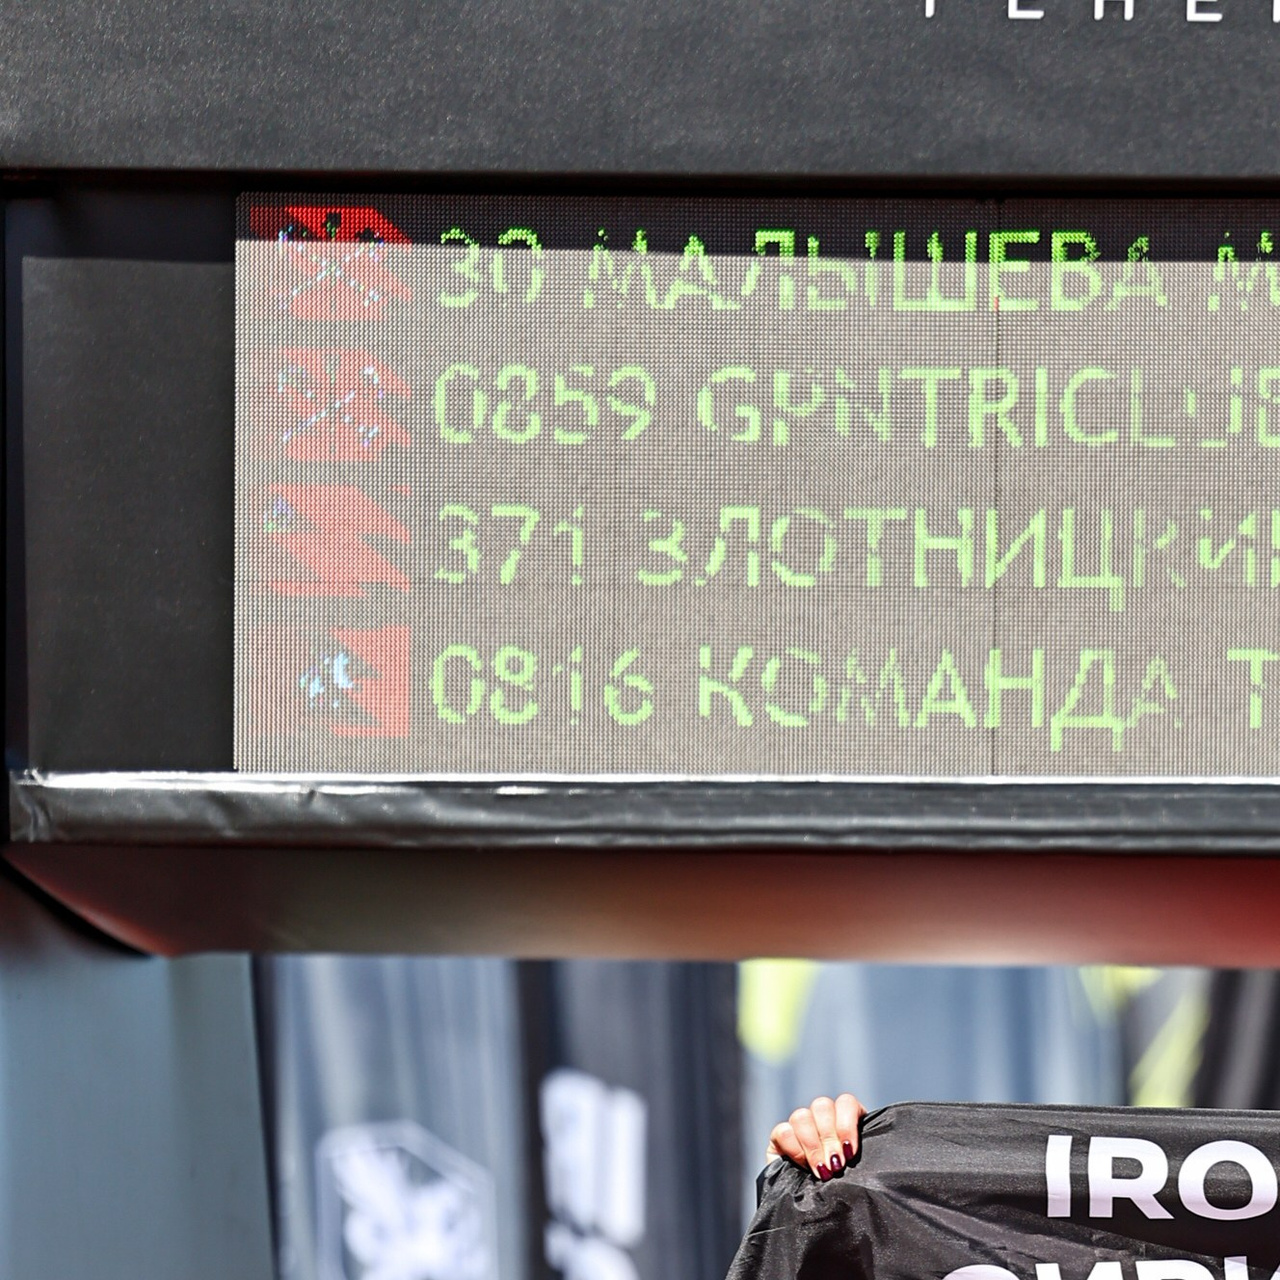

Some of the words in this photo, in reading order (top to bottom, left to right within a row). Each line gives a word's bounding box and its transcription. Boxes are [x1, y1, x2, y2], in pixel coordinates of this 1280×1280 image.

[440, 226, 546, 309] 30
[584, 227, 1168, 311] МАЛЫШЕВА
[433, 364, 657, 445] 0859
[435, 505, 584, 587] 371
[431, 645, 654, 727] 0816
[699, 646, 1181, 752] КОМАНДА
